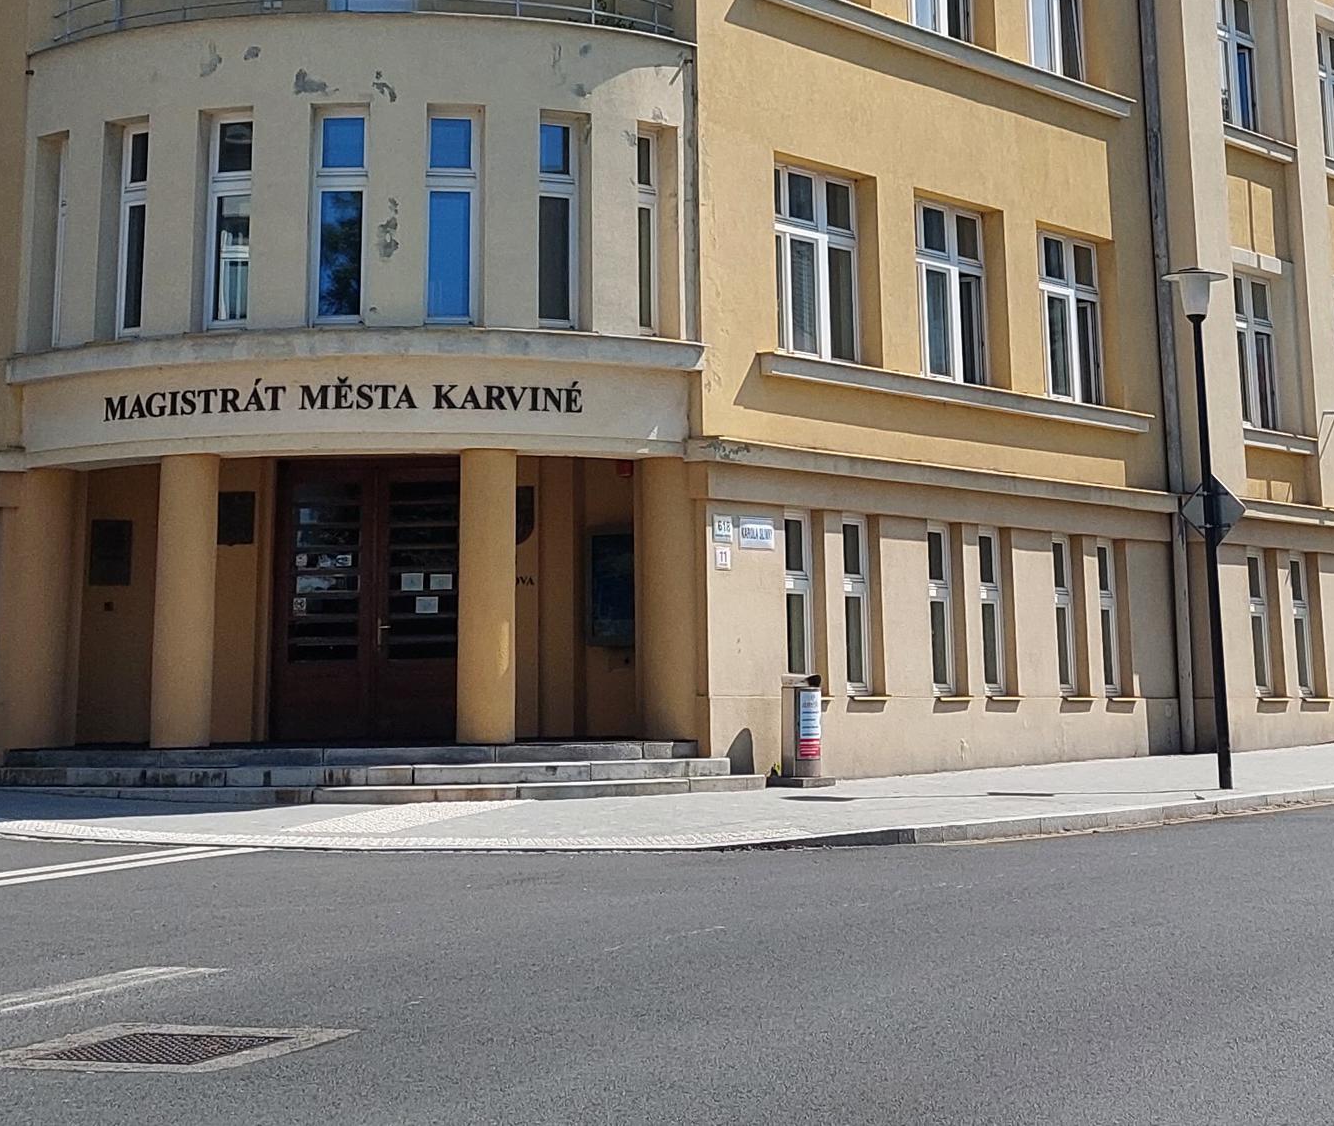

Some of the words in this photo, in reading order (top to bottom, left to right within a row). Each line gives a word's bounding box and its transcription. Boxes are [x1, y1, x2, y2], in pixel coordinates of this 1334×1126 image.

[103, 377, 287, 423] MAGISTRÁT
[298, 376, 418, 411] MĚSTA
[432, 380, 584, 414] KARVINÉ
[717, 520, 731, 533] 618
[719, 551, 728, 563] 11
